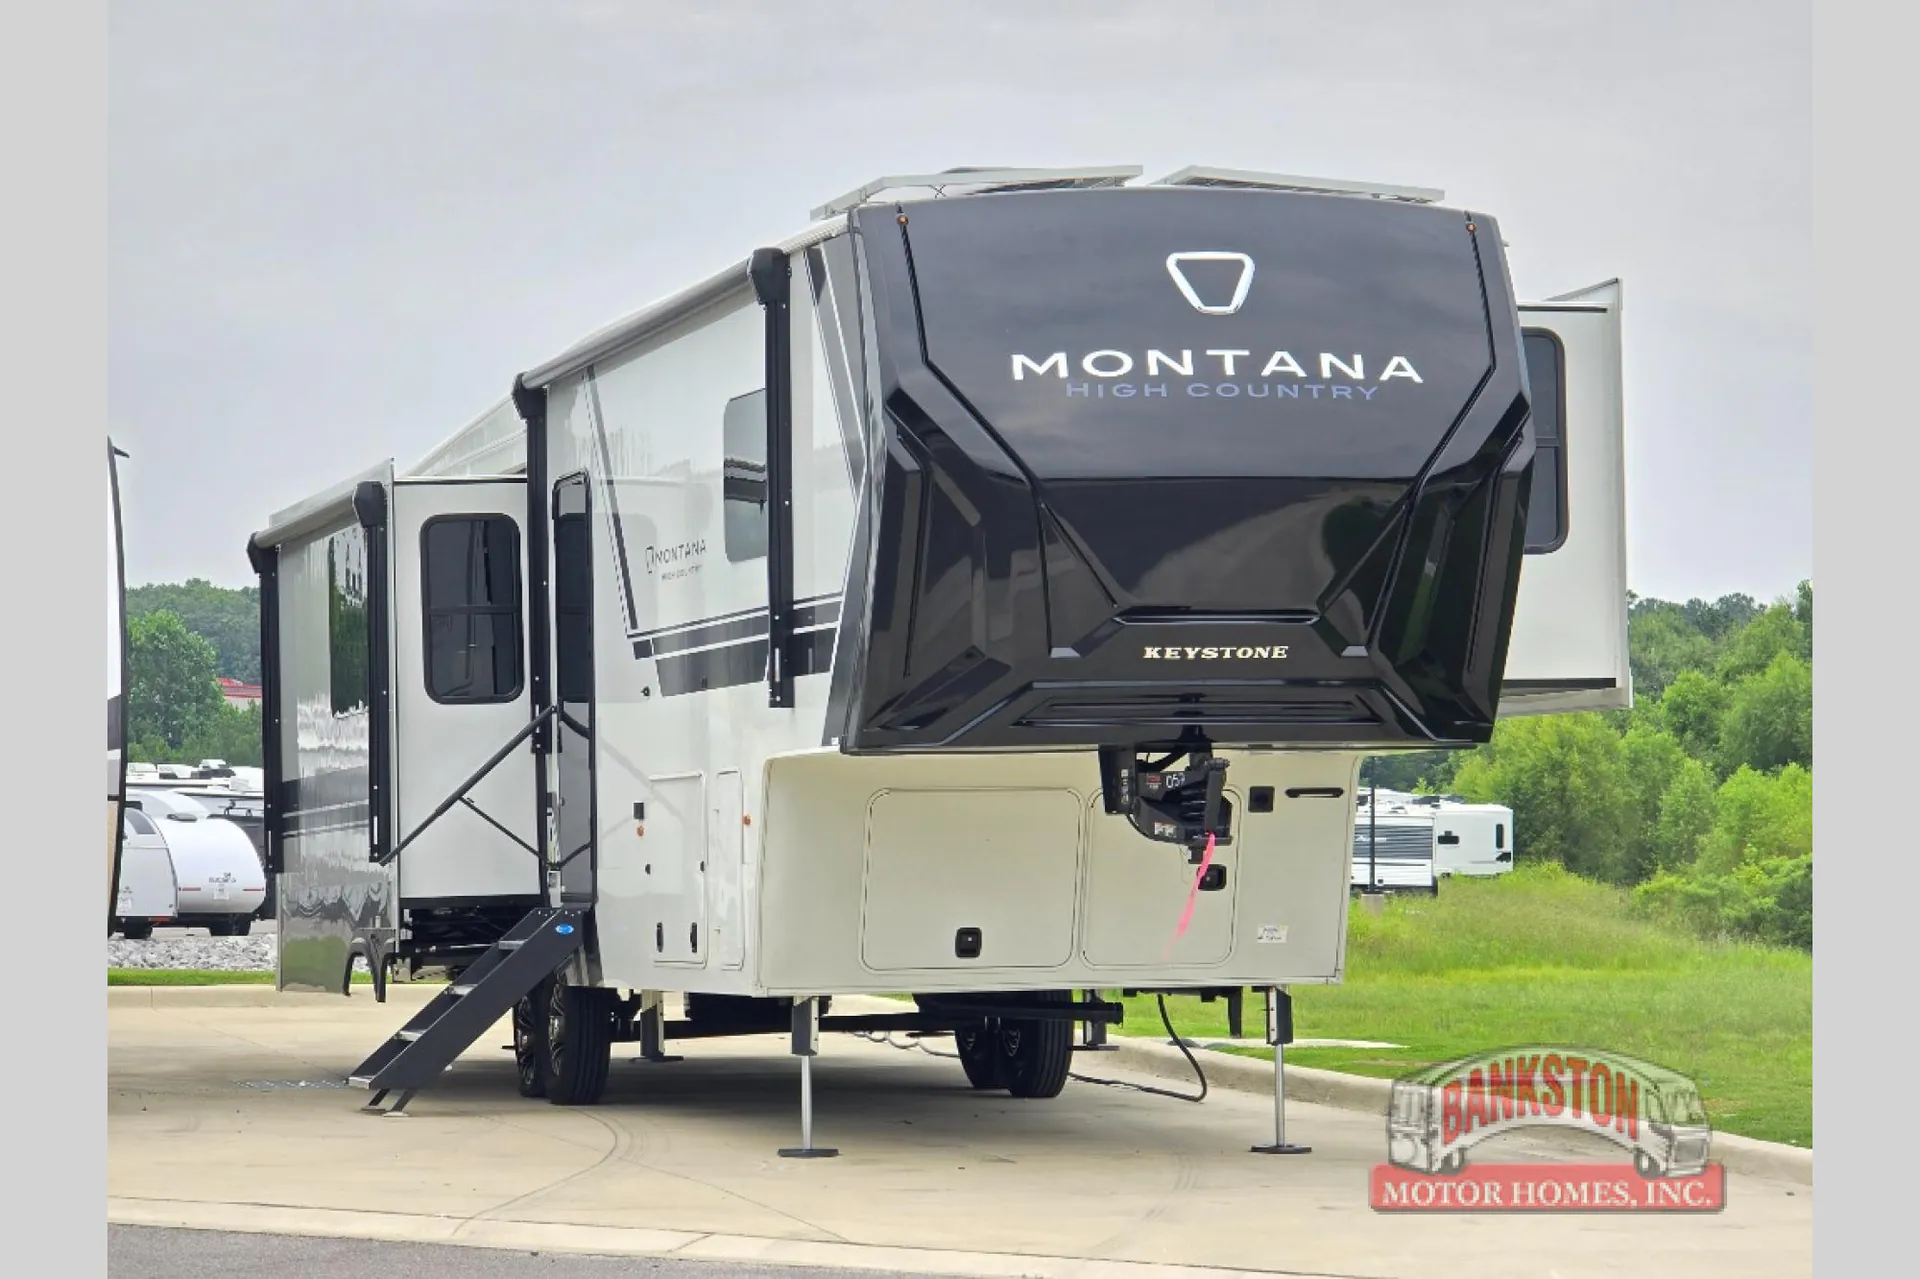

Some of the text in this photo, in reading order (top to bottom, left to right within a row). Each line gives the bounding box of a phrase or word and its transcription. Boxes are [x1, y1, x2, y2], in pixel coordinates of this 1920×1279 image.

[1011, 349, 1424, 383] MONTANA
[1065, 382, 1379, 401] HIGH COUNTRY
[655, 540, 707, 565] MONTANA
[1142, 646, 1289, 660] KEYSTONE
